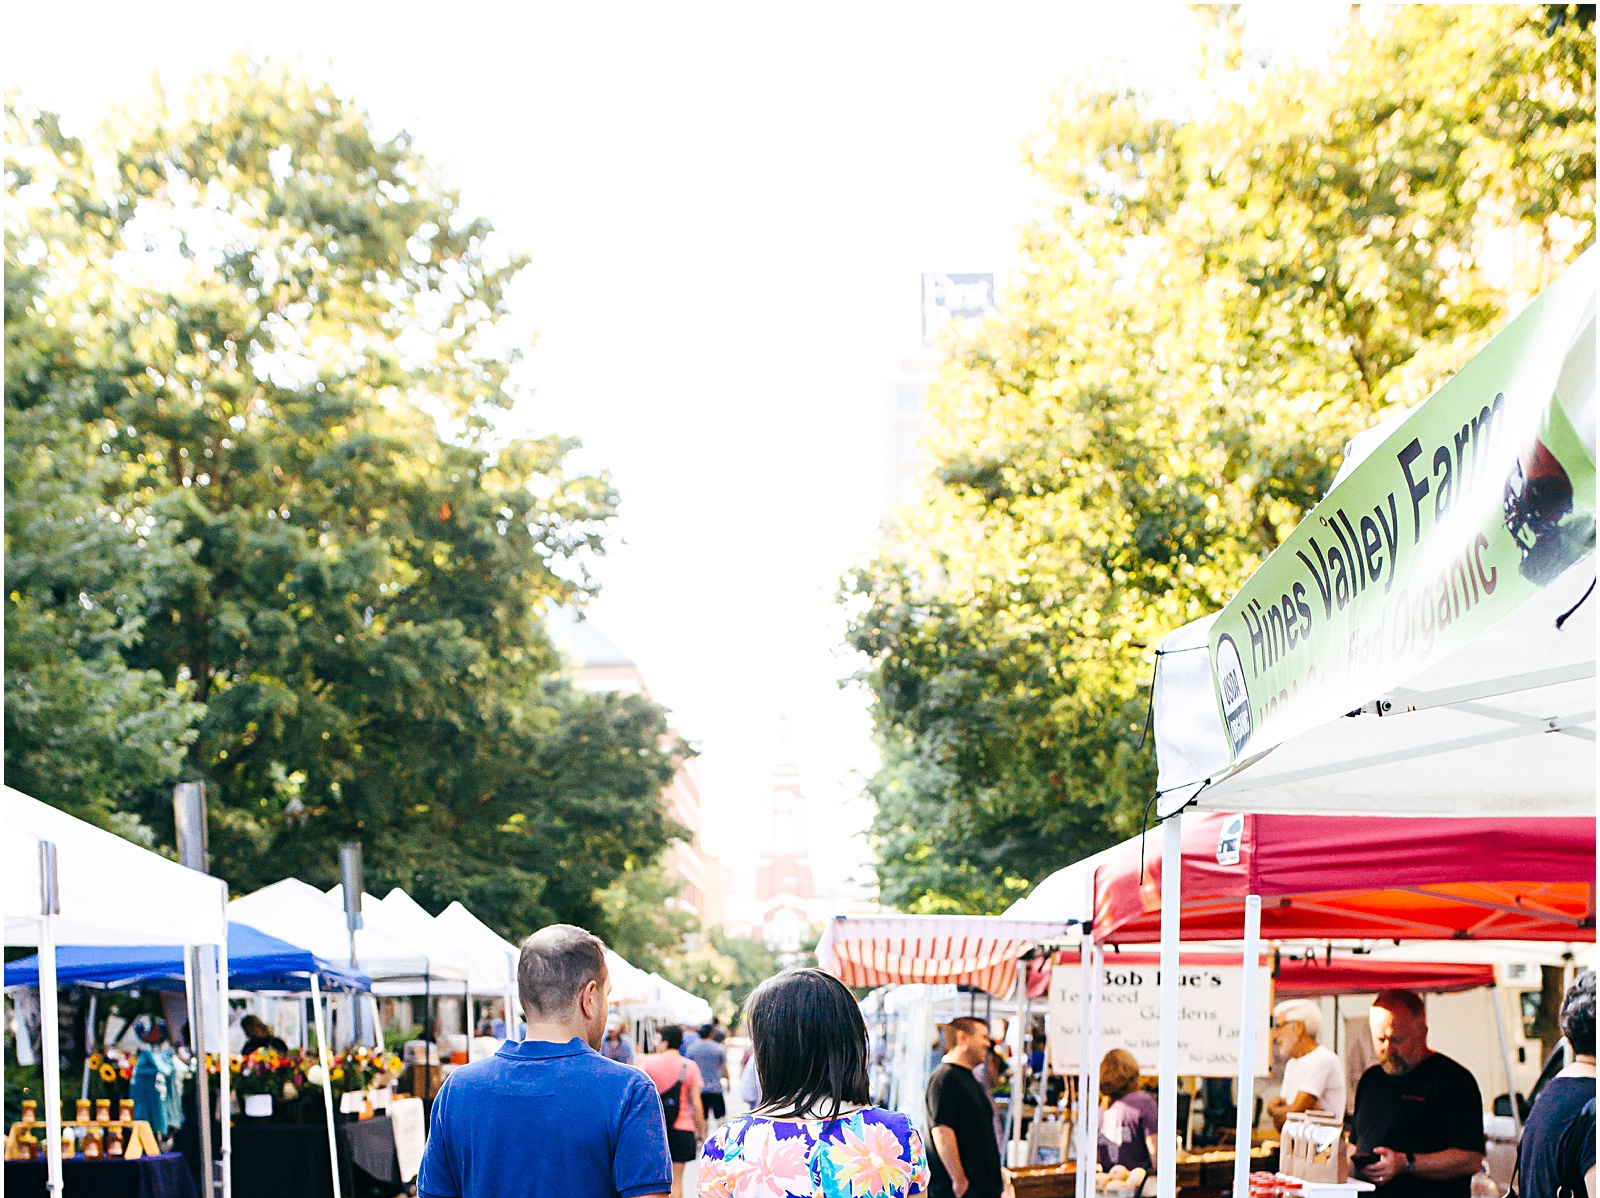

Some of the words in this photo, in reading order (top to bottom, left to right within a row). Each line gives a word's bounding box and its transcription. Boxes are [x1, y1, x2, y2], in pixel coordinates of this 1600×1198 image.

[1241, 598, 1312, 680] Hines
[1296, 493, 1399, 620] Valley
[1392, 532, 1498, 662] Organic
